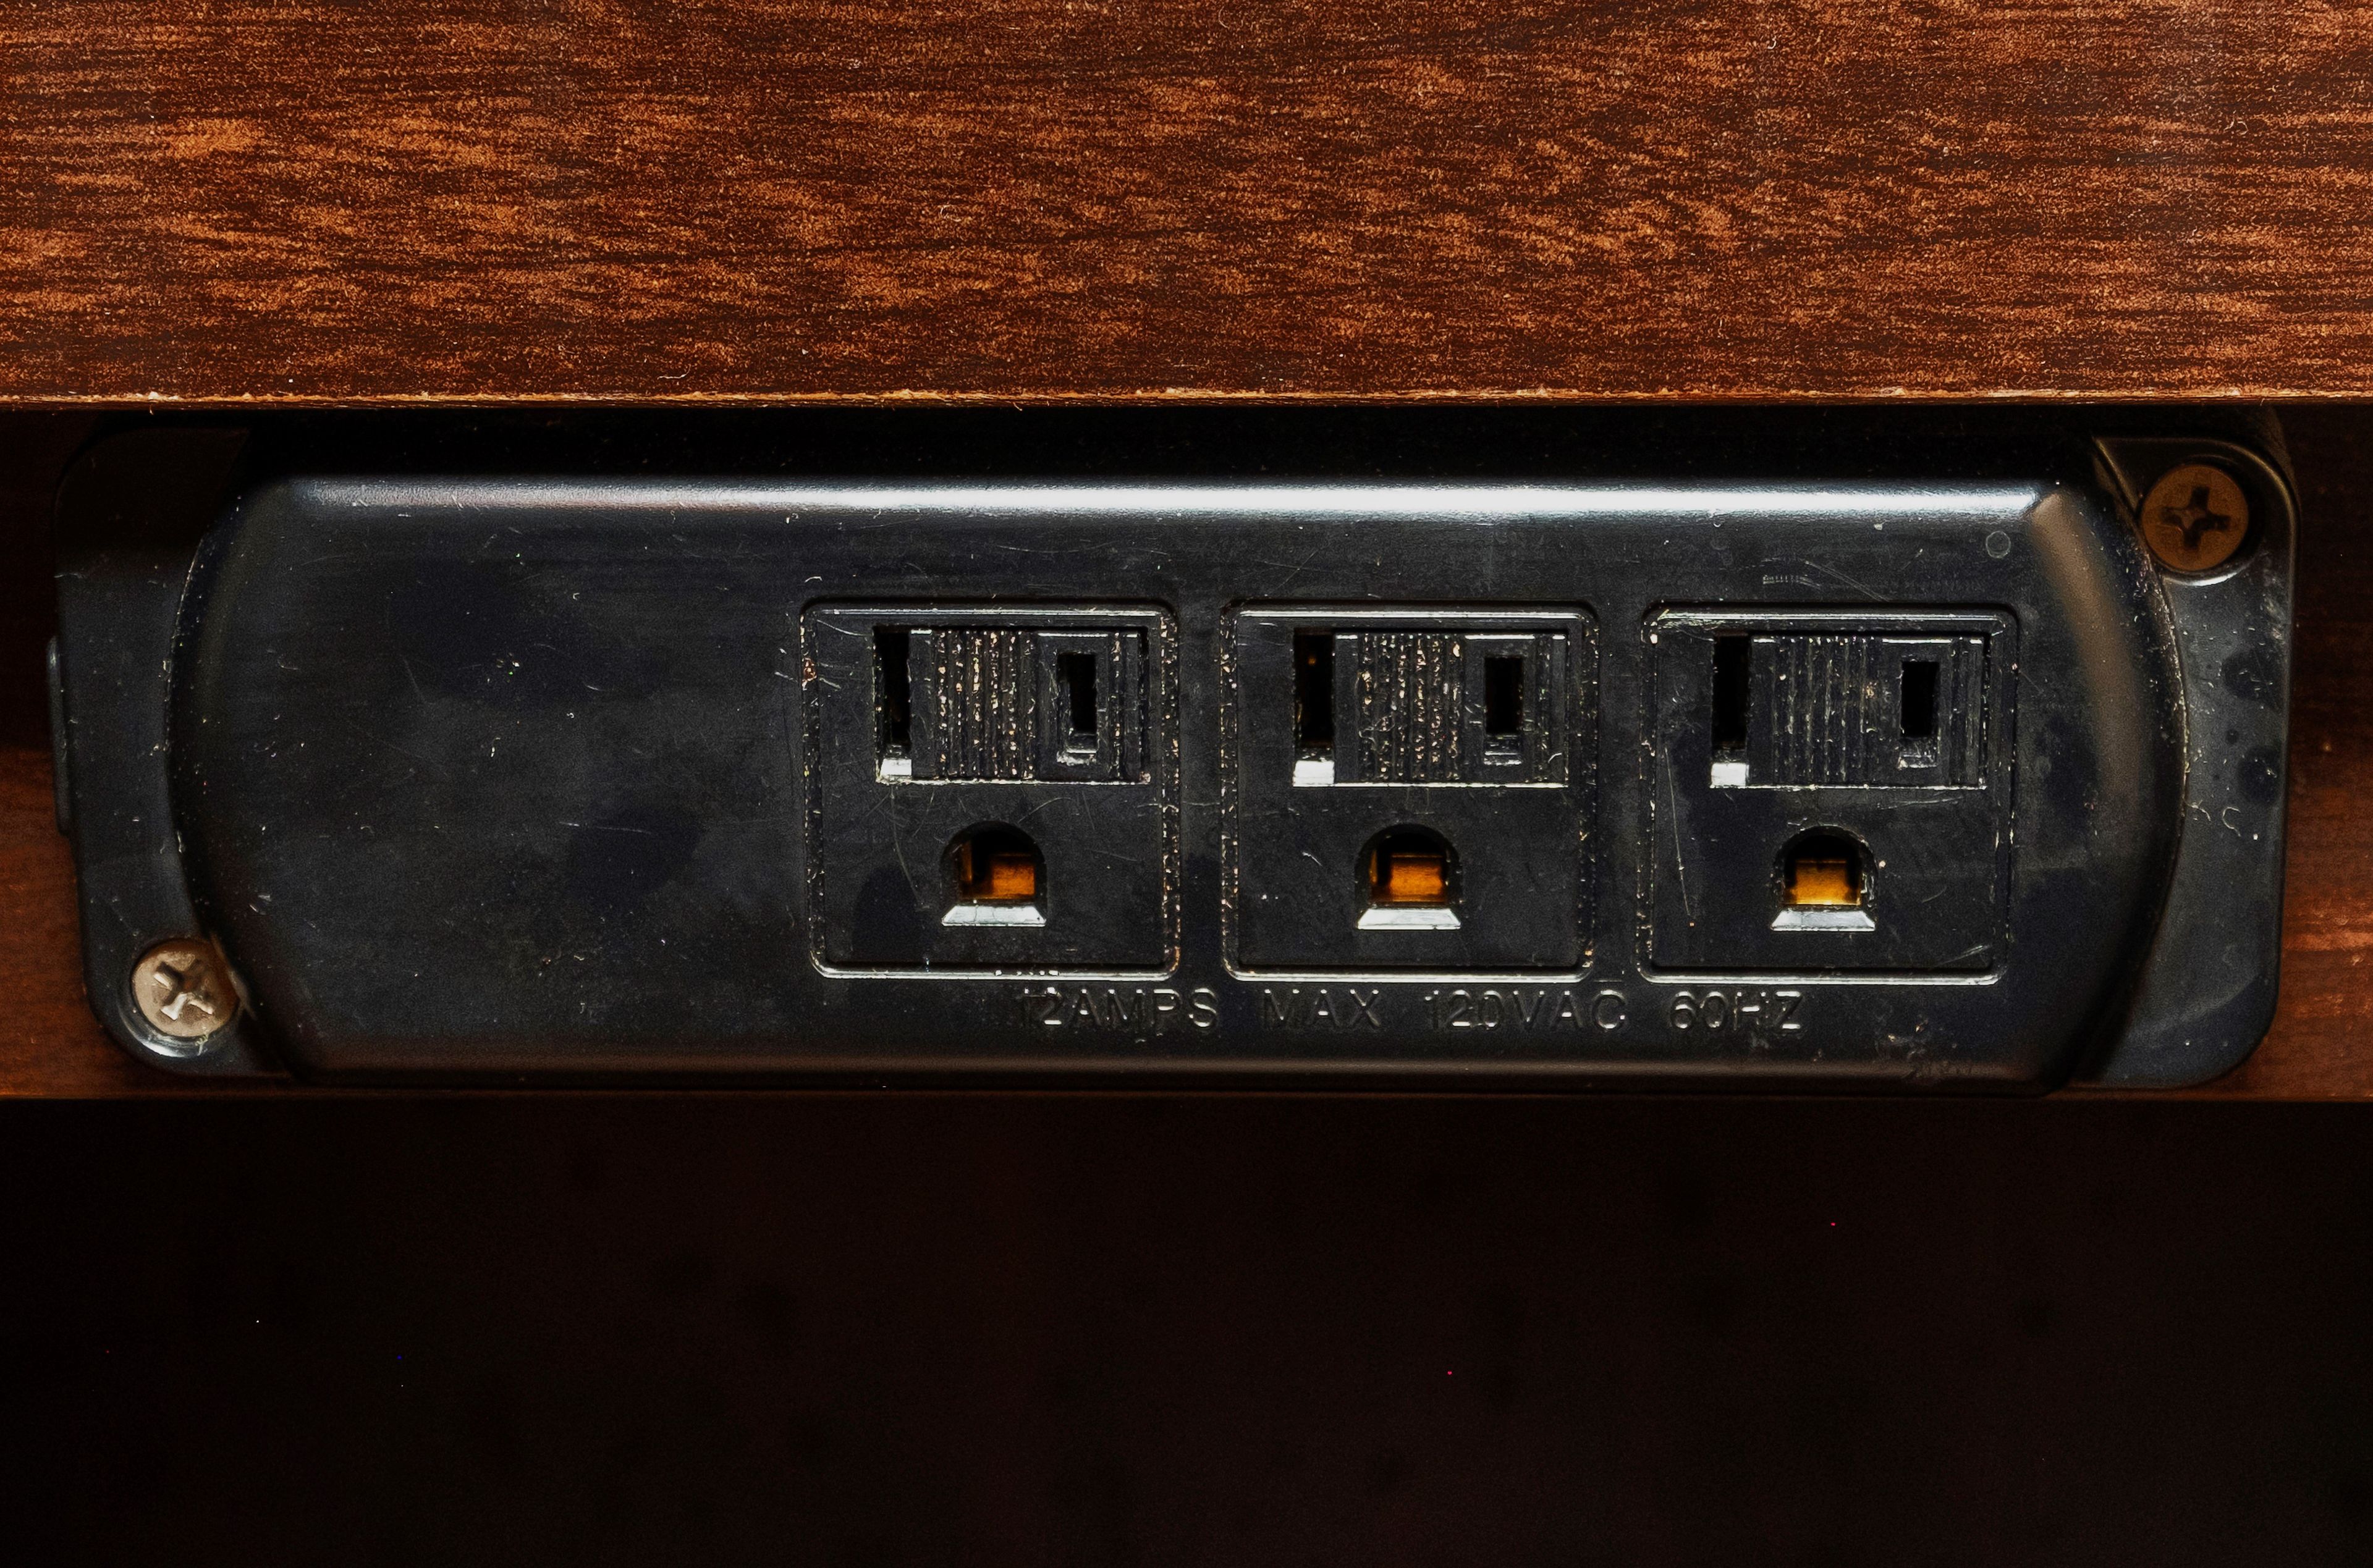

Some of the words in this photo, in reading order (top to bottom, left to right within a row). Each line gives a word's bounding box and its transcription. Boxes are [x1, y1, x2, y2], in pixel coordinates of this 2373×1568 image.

[1021, 987, 1219, 1028] 12AMPS
[1262, 988, 1382, 1028] MAX
[1424, 990, 1628, 1031] 120VAC
[1669, 990, 1803, 1031] 60HZ
